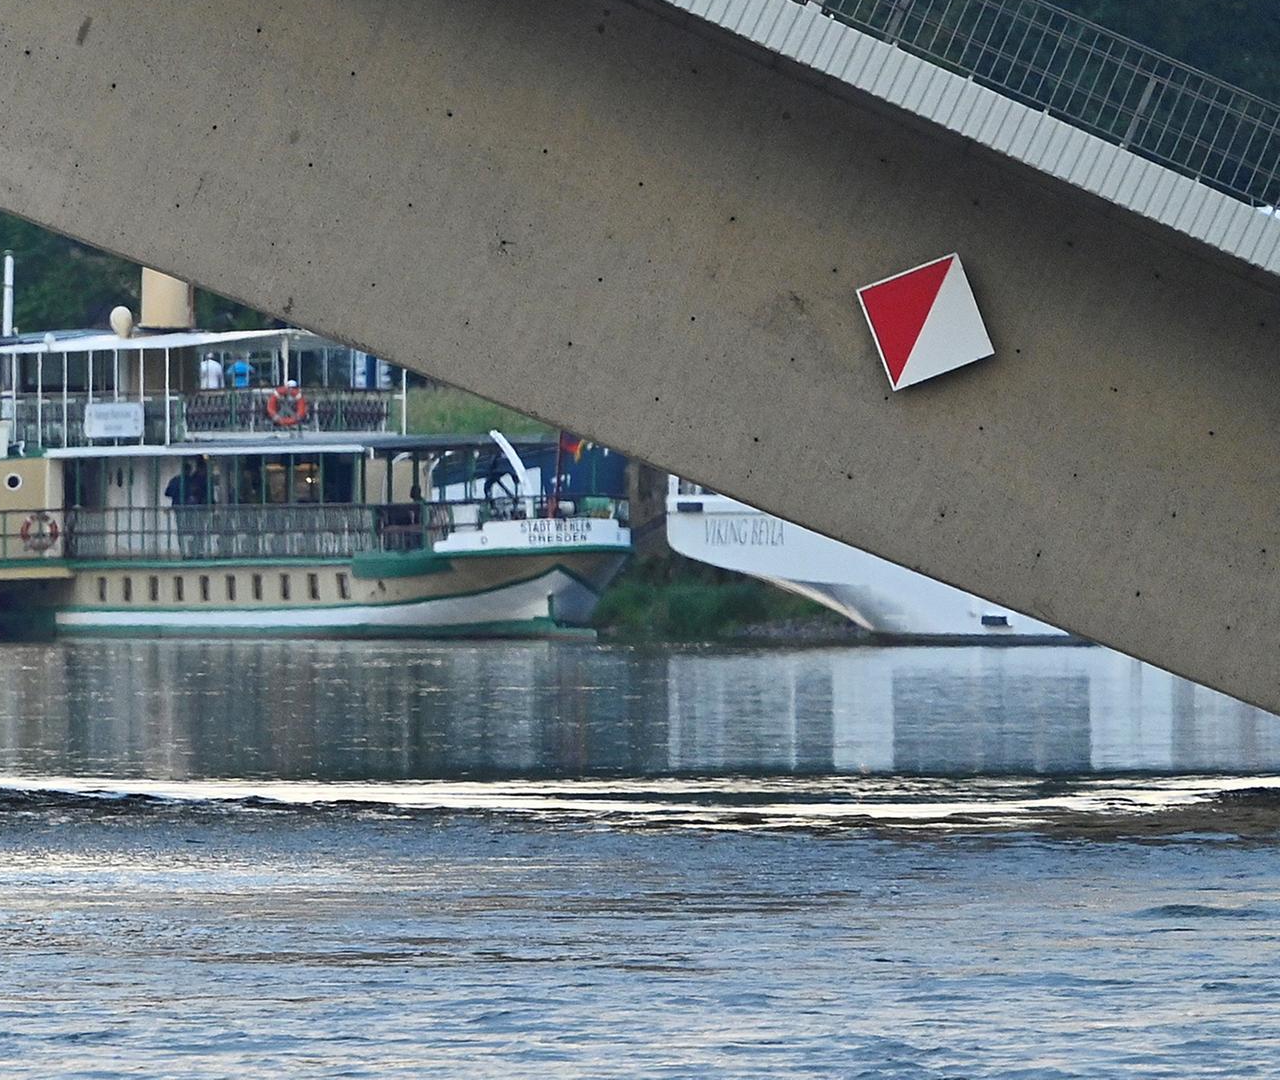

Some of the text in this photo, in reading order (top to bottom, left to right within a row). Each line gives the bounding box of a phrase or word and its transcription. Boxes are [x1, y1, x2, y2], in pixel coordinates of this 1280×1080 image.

[520, 520, 551, 533] STADT
[705, 519, 748, 545] VIKING
[528, 532, 587, 543] DRESDEN
